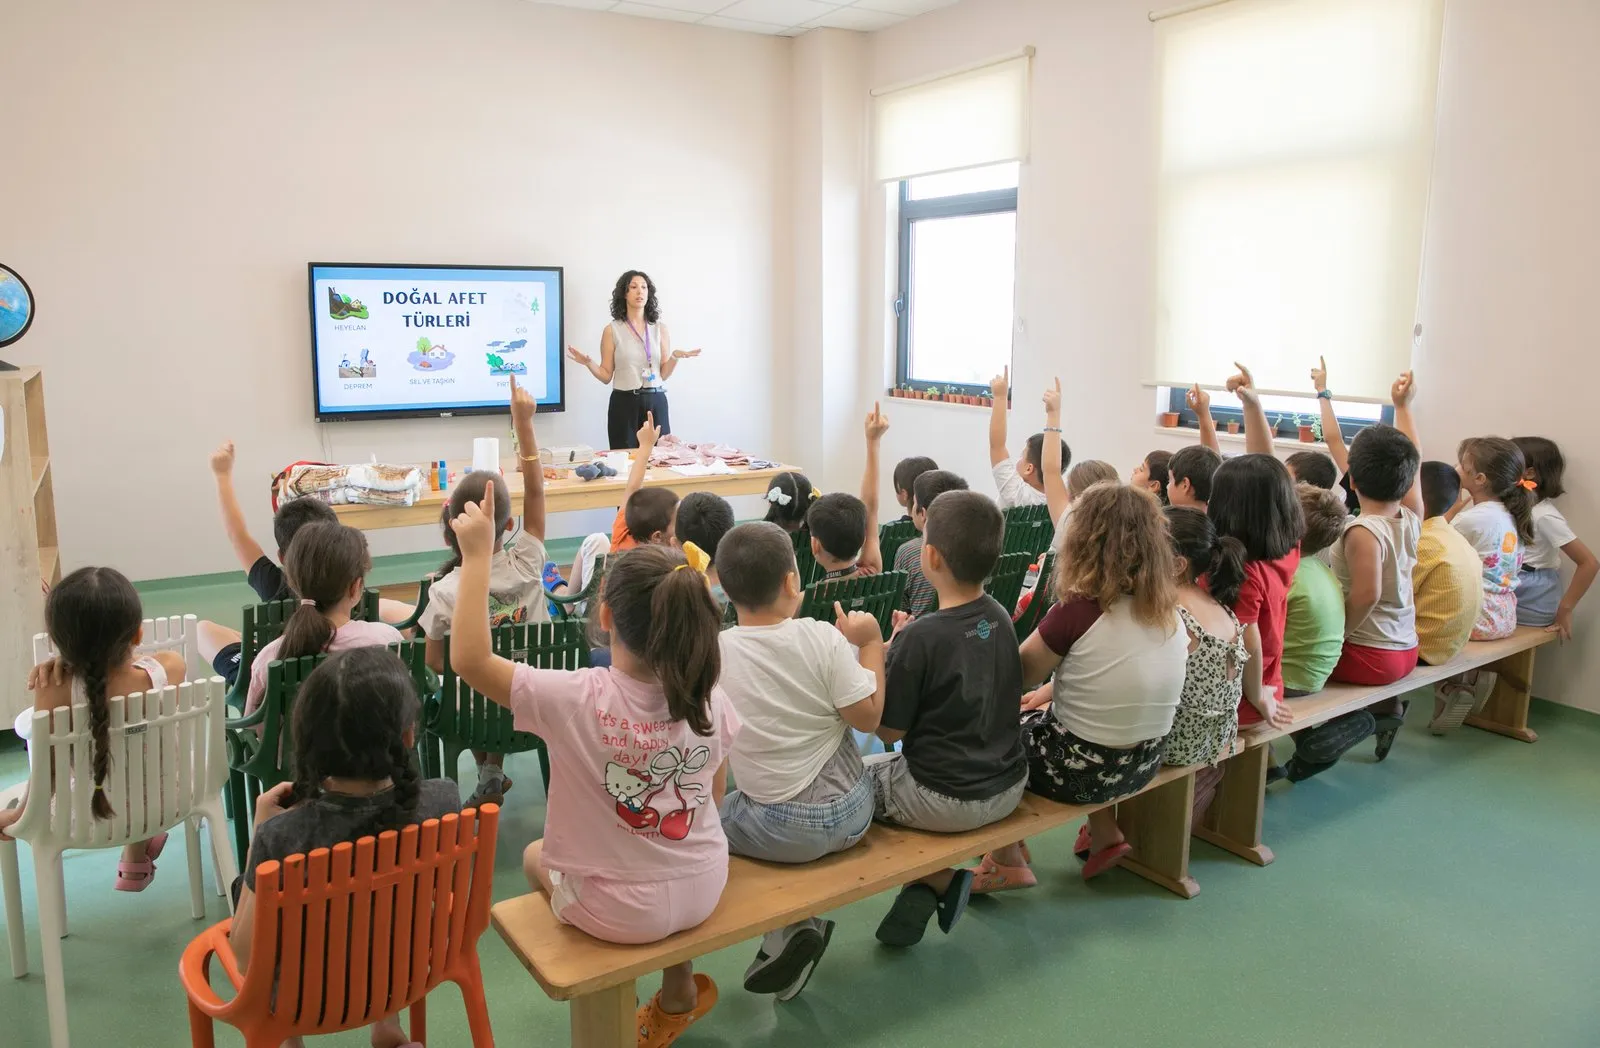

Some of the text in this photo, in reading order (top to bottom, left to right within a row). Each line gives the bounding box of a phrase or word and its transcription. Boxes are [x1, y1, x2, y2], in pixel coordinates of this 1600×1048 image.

[383, 287, 488, 305] DOĞAL AFET
[334, 323, 367, 331] HEYELAN
[402, 311, 471, 328] TÜRLERİ
[343, 382, 373, 390] DEPREM
[432, 377, 456, 386] TAŞKIN
[620, 719, 630, 731] a
[632, 719, 673, 735] sweet
[602, 734, 669, 753] and happy
[613, 749, 648, 767] day!
